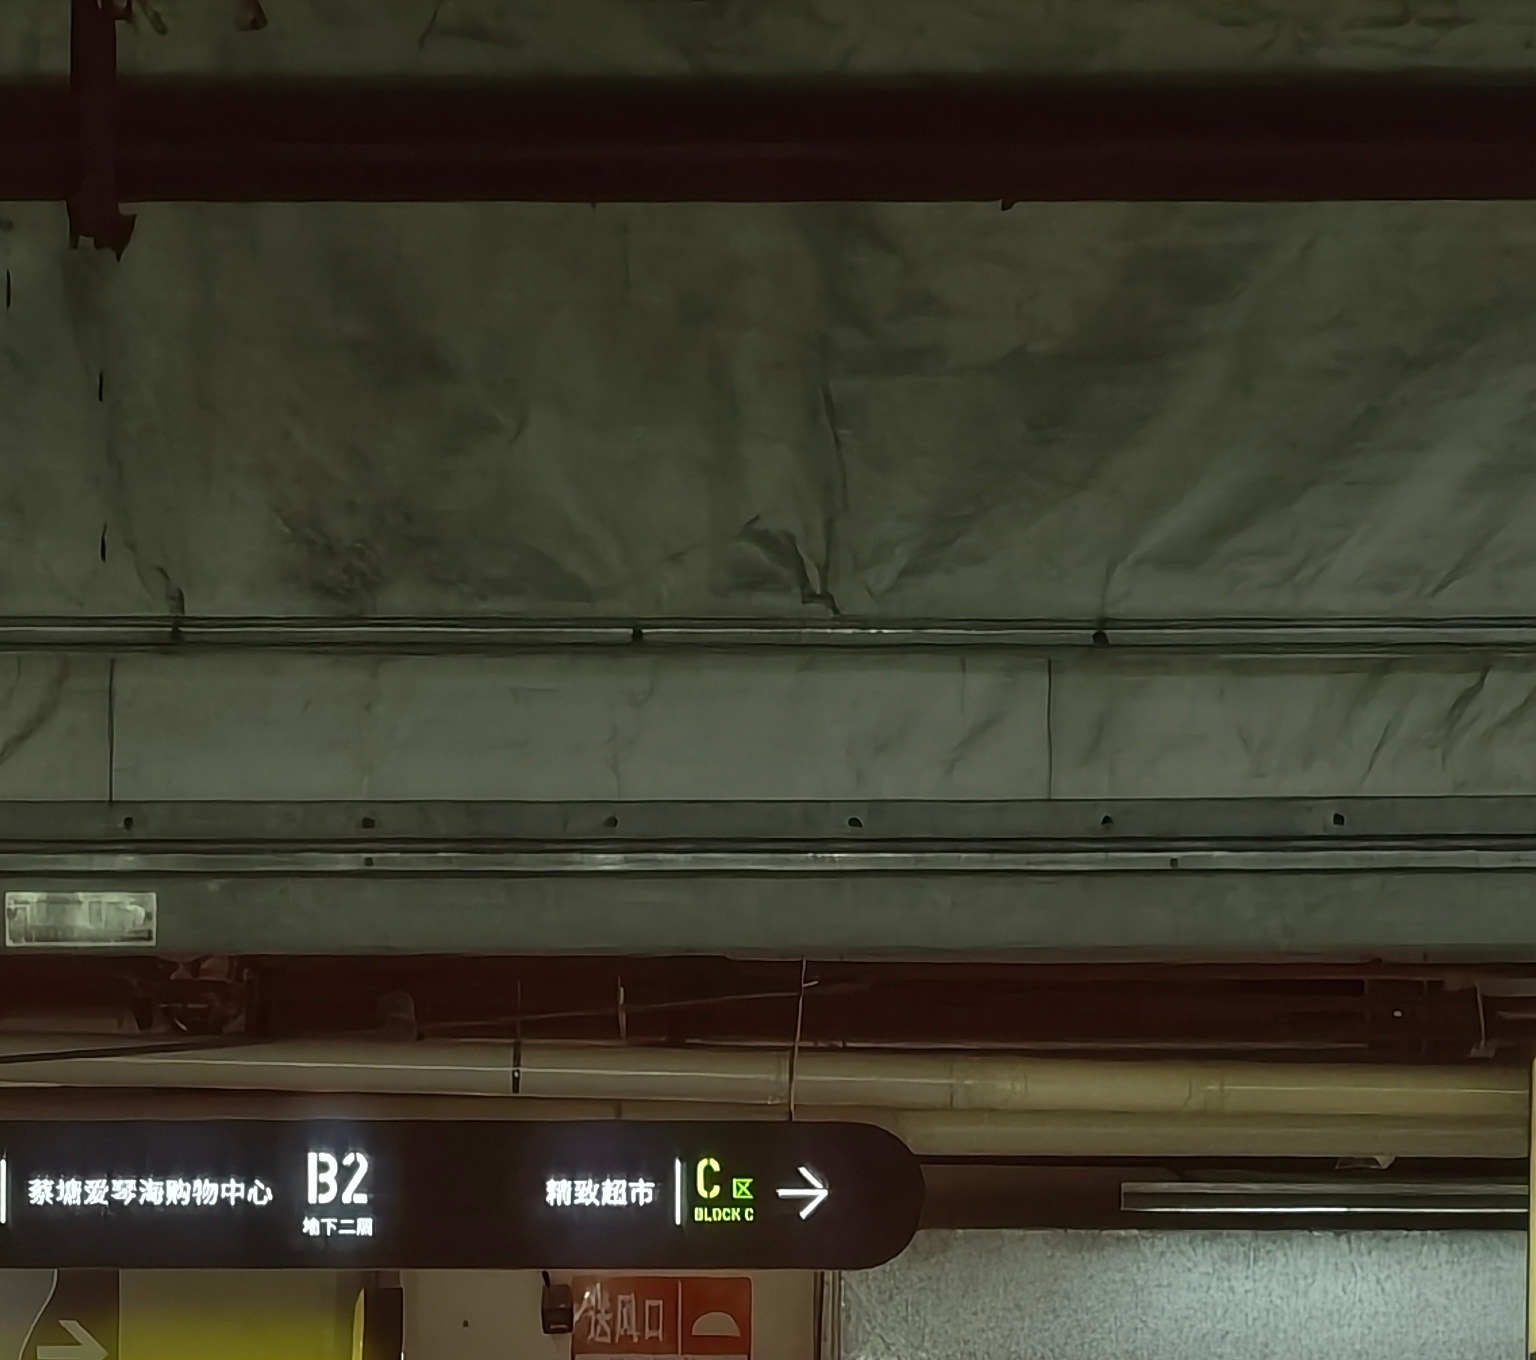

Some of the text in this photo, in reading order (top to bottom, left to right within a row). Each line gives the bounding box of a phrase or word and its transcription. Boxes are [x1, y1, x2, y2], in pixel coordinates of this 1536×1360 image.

[307, 1151, 369, 1205] B2
[694, 1206, 754, 1222] BLOCK C
